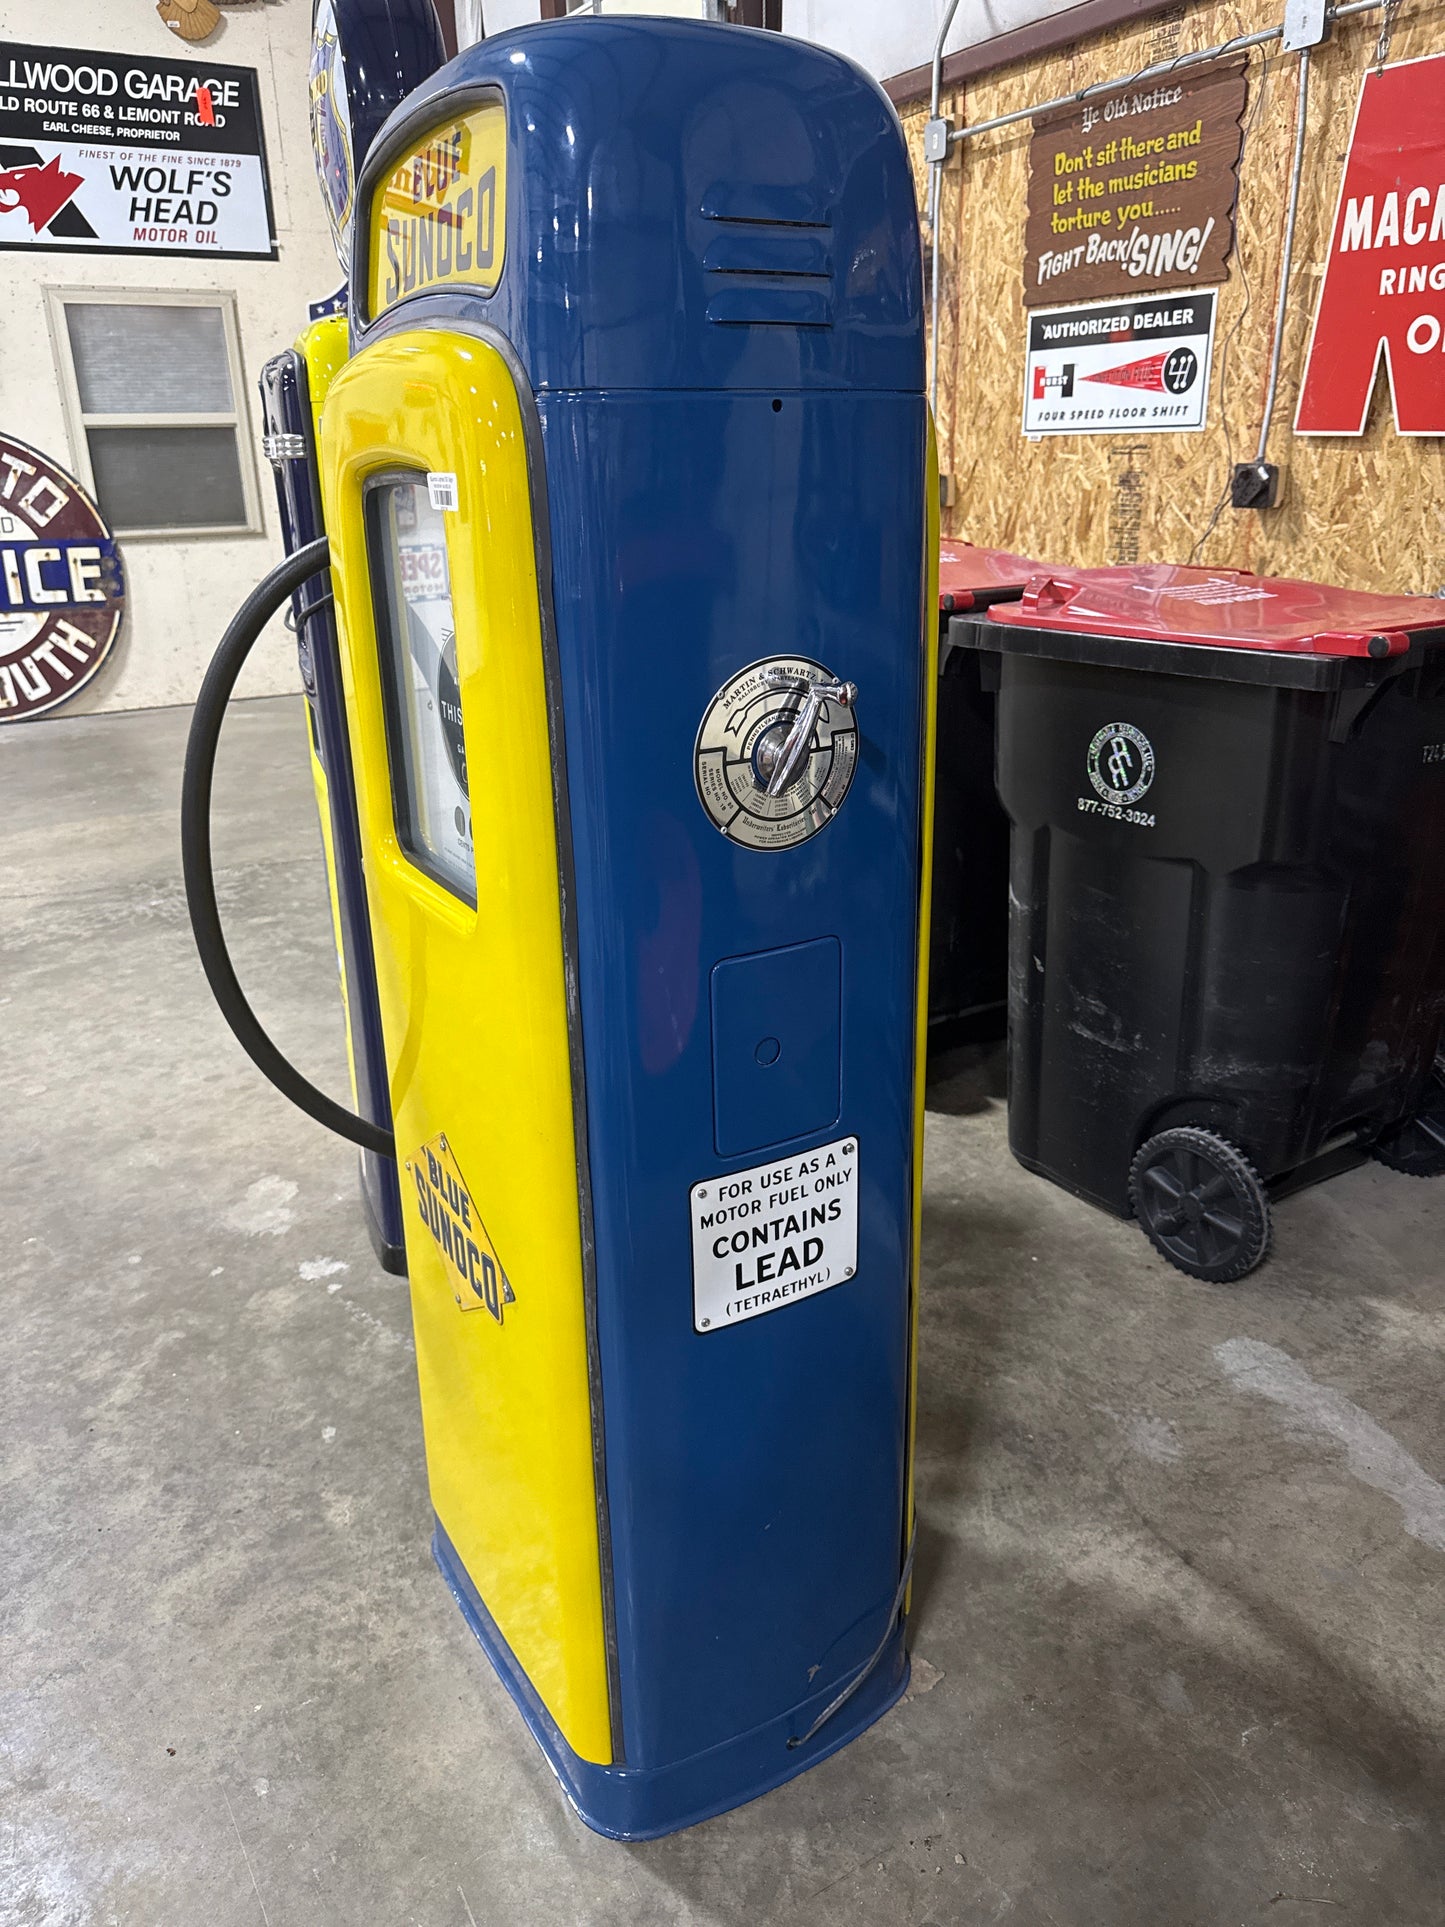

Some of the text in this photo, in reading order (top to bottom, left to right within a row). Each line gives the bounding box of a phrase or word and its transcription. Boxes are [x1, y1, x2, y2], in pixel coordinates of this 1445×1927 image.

[124, 69, 240, 107] GARAGE
[24, 98, 78, 116] ROUTE
[82, 103, 100, 119] 66
[104, 105, 115, 119] &
[119, 106, 180, 125] LEMONT
[1081, 85, 1183, 134] Ye Old Notice
[43, 121, 180, 142] EARL CHEESE, PROPRIETOR
[1054, 119, 1202, 176] Don't sit there and
[79, 150, 241, 168] FINEST OF THE FINE SINCE 1879
[109, 165, 232, 197] WOLF'S
[1053, 160, 1198, 206] let the musicians
[129, 197, 218, 225] HEAD
[1051, 207, 1112, 234] torture
[133, 227, 218, 244] MOTOR OIL
[386, 165, 496, 305] SUNOCO
[1127, 217, 1215, 277] SING!
[1043, 308, 1194, 340] AUTHORIZED DEALER
[1038, 405, 1189, 422] FOUR SPEED FLOOR SHIFT
[723, 677, 756, 710] MARTIN
[441, 700, 463, 726] THIS
[1077, 797, 1156, 827] 877-752-3024
[426, 1147, 472, 1233] BLUE
[719, 1153, 836, 1201] FOR USE AS A
[700, 1168, 852, 1229] MOTOR FUEL ONLY
[414, 1162, 500, 1321] SUNOCO
[712, 1198, 842, 1259] CONTAINS
[735, 1237, 824, 1291] LEAD
